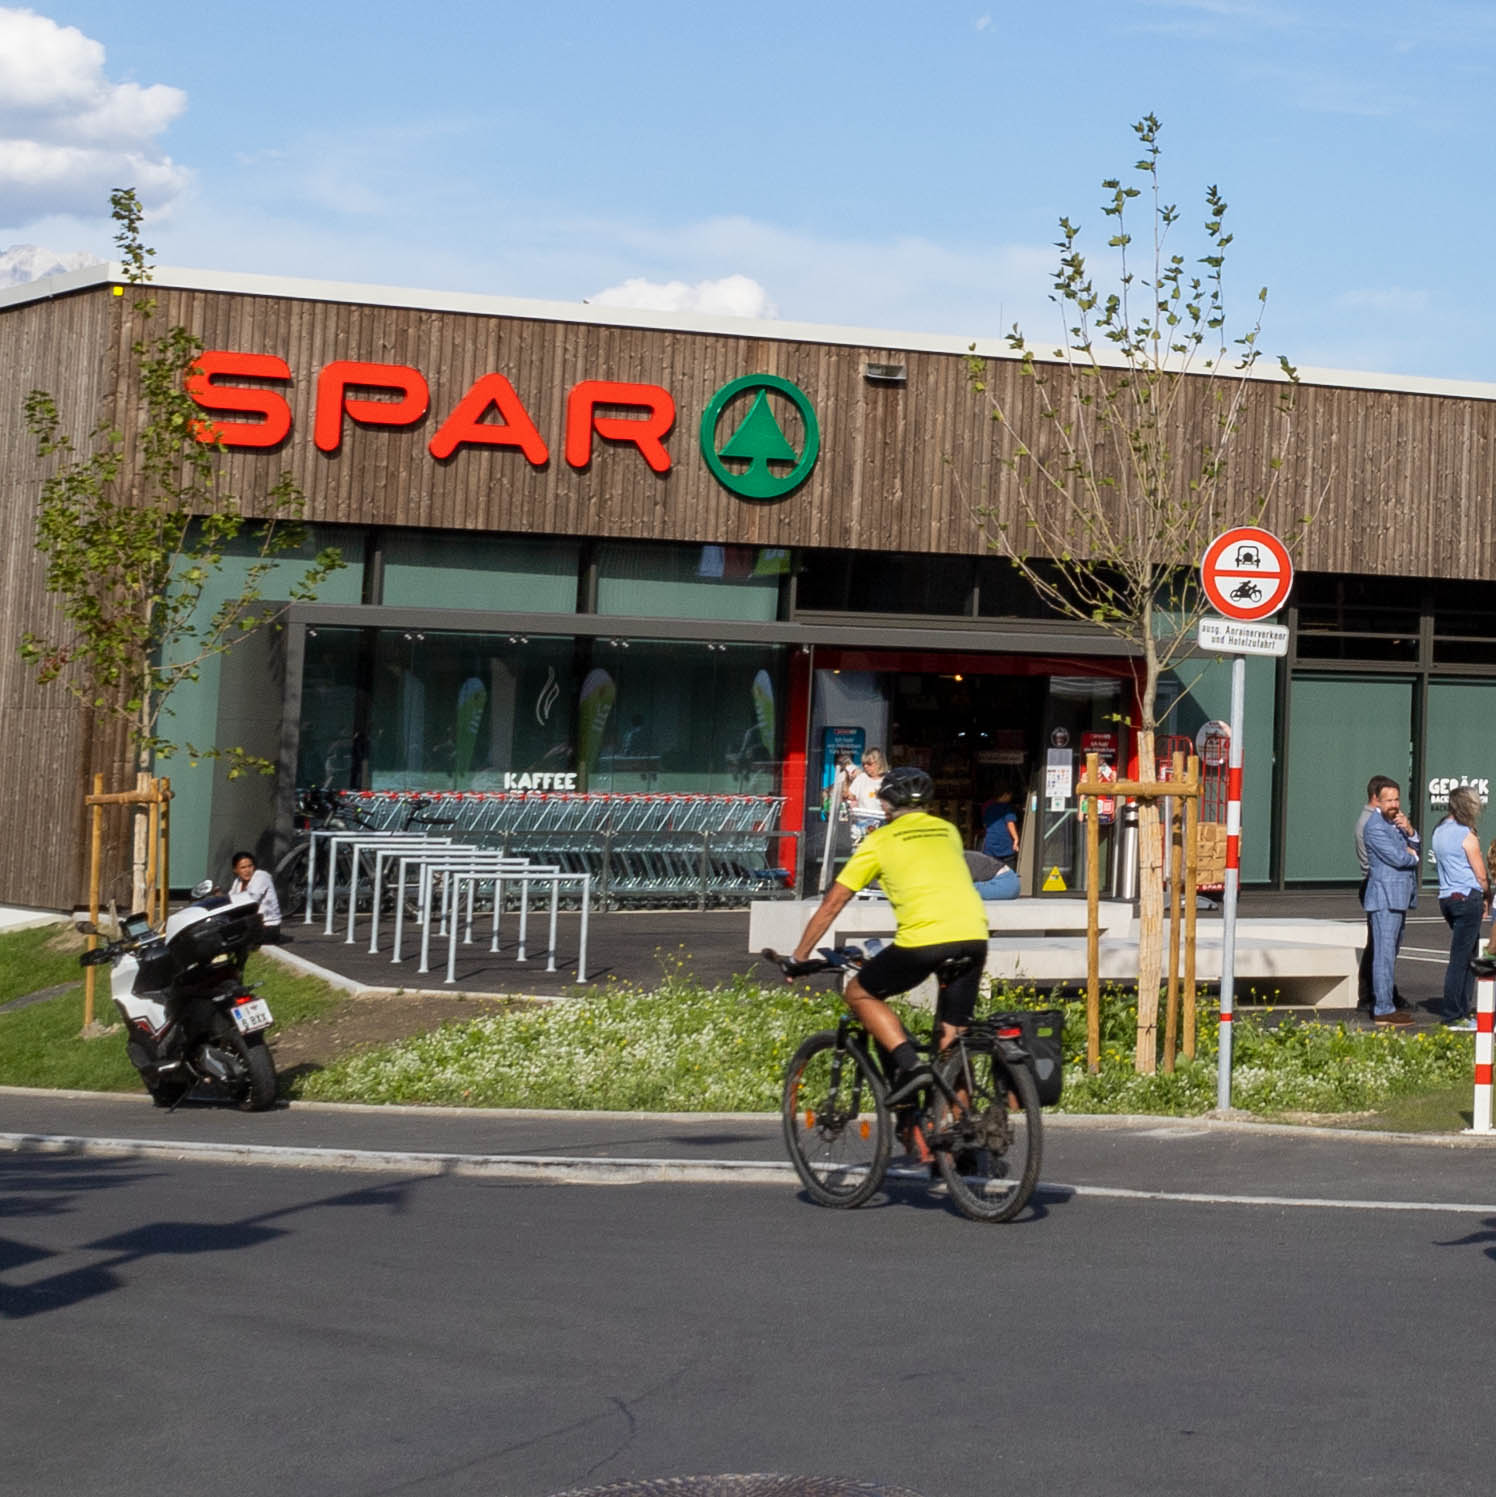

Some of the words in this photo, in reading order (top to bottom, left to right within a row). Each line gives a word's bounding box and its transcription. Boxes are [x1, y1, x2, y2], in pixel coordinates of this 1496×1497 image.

[184, 350, 676, 473] SPAR
[1202, 625, 1222, 635] ausg.
[1211, 635, 1225, 644] und
[1228, 636, 1276, 650] Hotelzufahrt
[504, 771, 577, 789] KAFFEE
